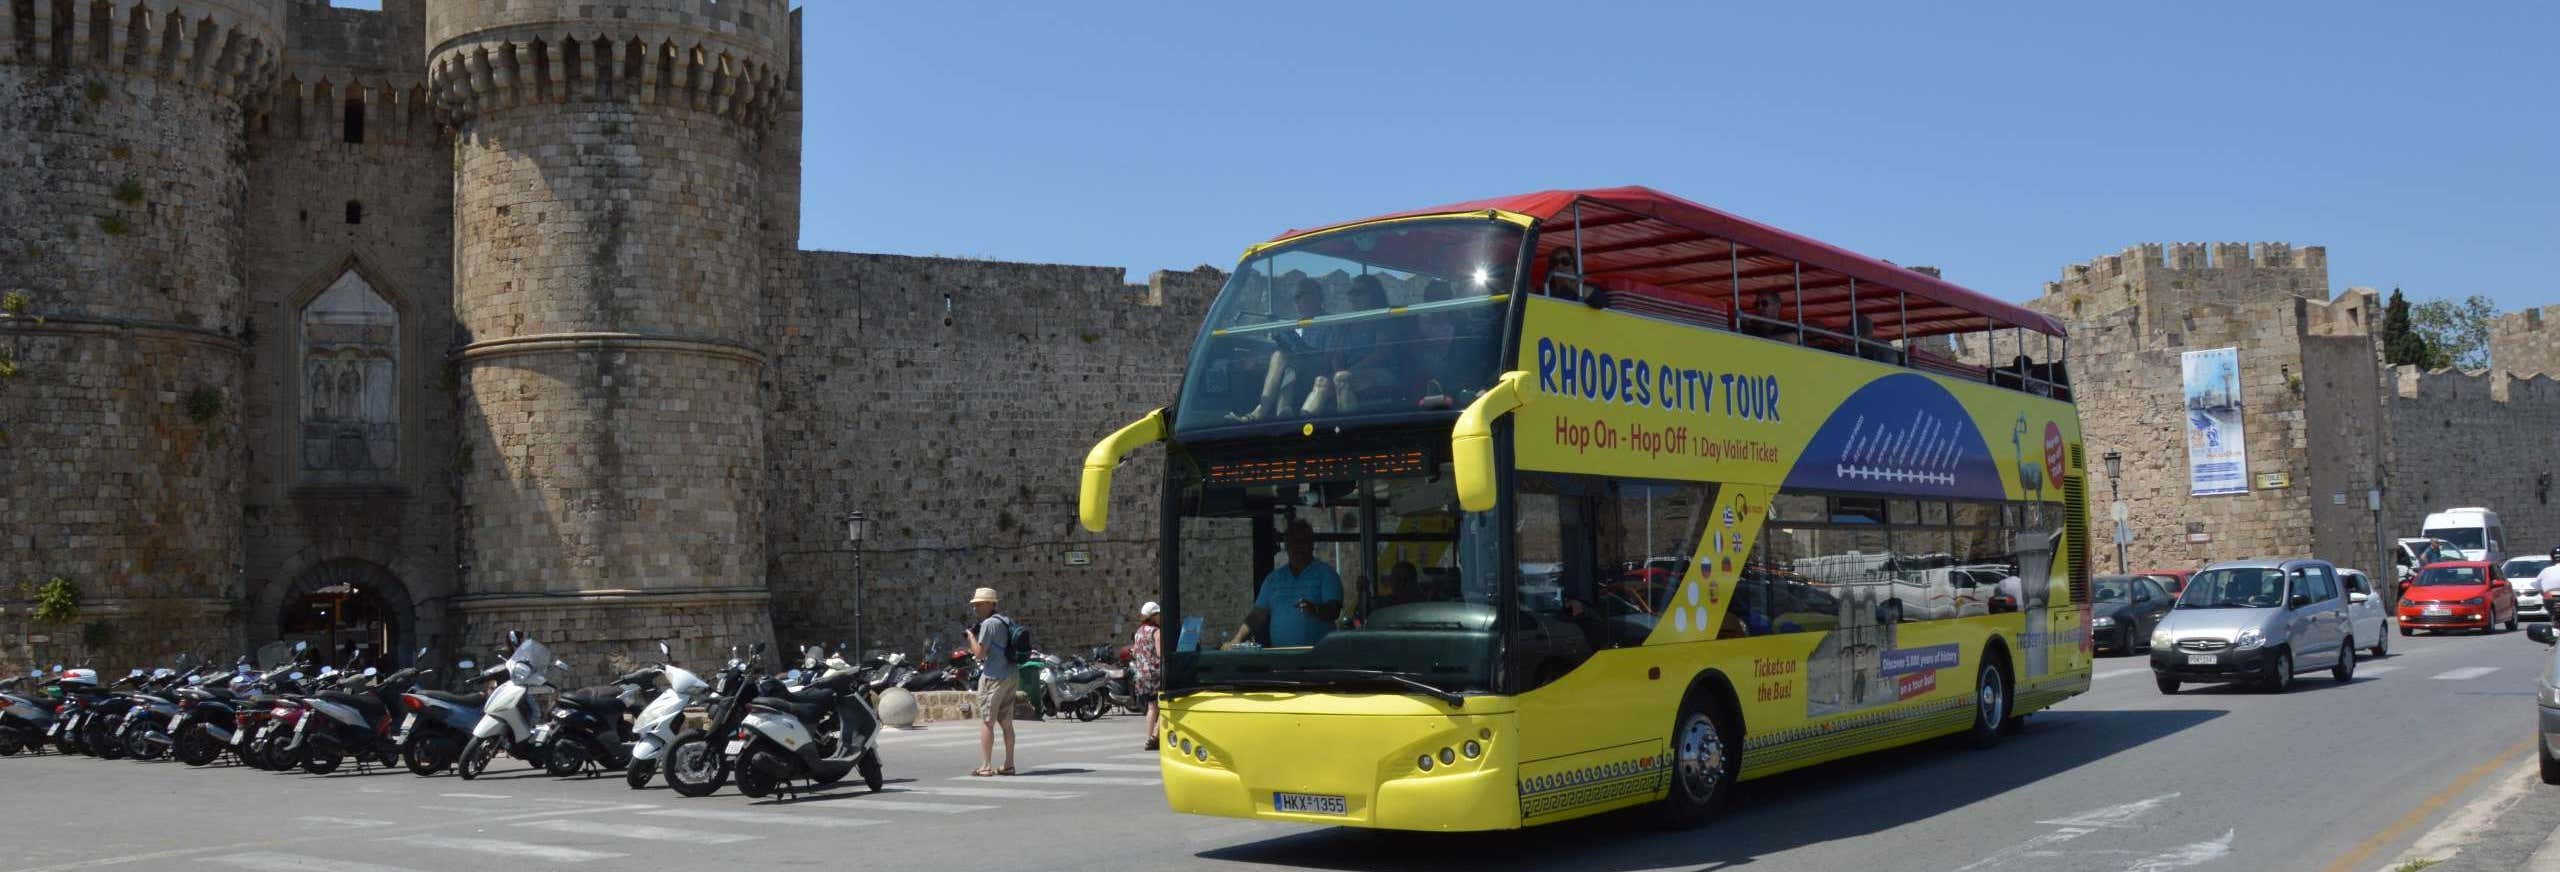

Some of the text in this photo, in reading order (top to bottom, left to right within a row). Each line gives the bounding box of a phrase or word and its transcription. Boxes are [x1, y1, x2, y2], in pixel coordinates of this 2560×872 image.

[1538, 337, 1781, 422] RHODES CITY TOUR
[1555, 415, 1590, 453] Hop
[1594, 419, 1617, 450] On
[1631, 423, 1661, 459] Hop
[1665, 427, 1688, 455] Off
[1692, 438, 1698, 457] 1
[1701, 438, 1722, 463] Day
[1723, 439, 1750, 460] Valid
[1750, 440, 1779, 464] Ticket
[1754, 657, 1784, 678] Tickets
[1758, 679, 1793, 702] the Bus!
